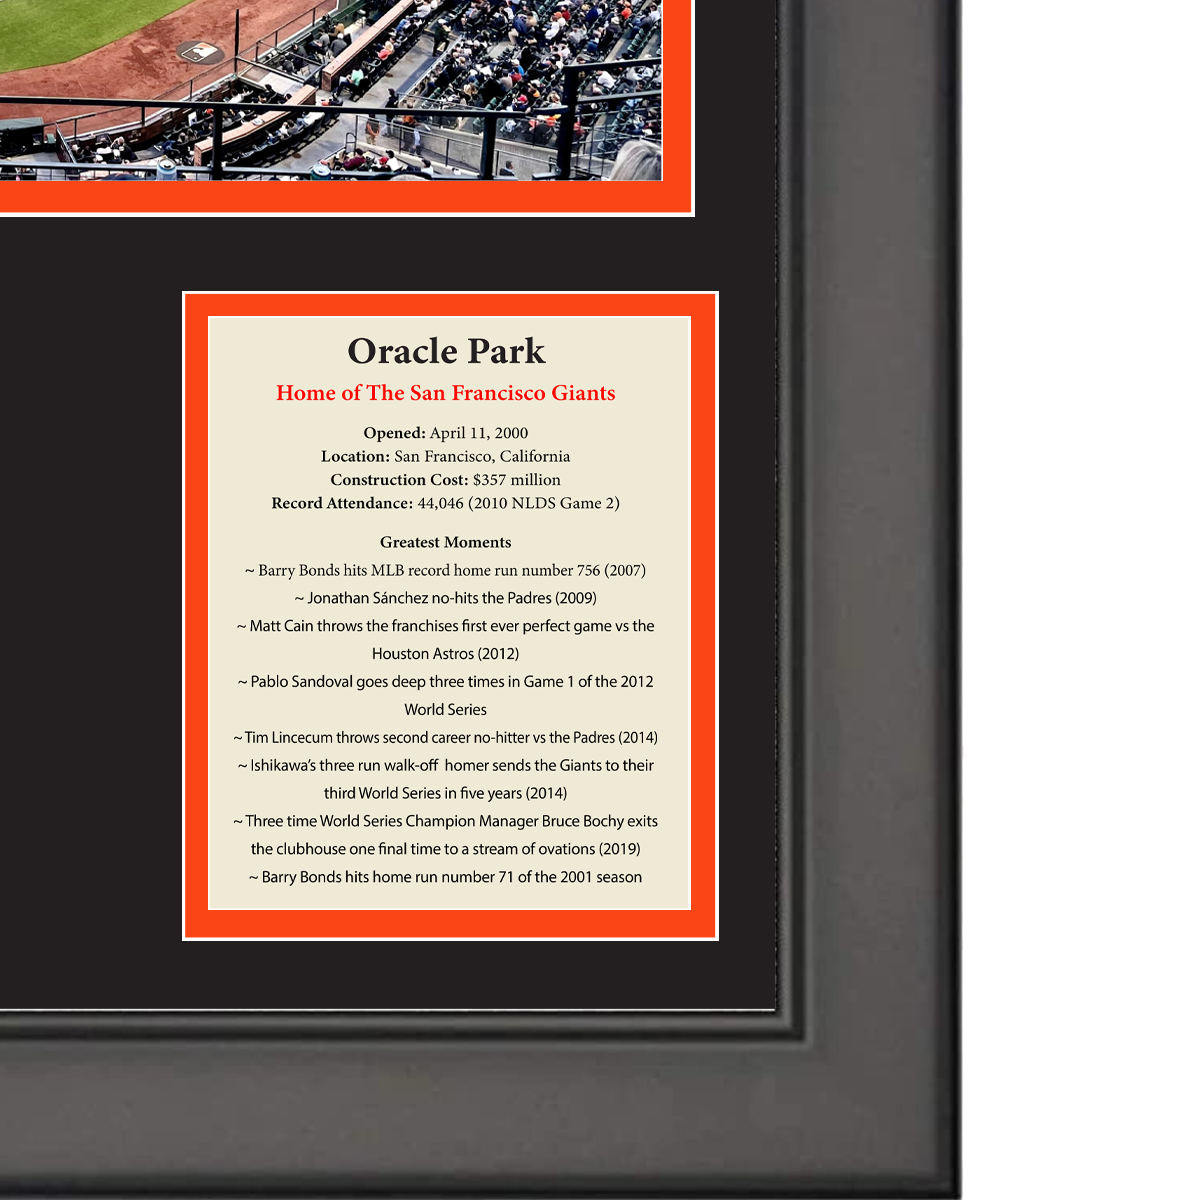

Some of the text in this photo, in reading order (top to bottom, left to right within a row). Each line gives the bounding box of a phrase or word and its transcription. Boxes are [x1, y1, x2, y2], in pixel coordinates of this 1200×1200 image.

[347, 336, 547, 365] Oracle Park
[276, 383, 616, 402] Home of The San Francisco Giants
[363, 425, 529, 443] Opened: April 11, 2000
[320, 448, 571, 464] Location: San Francisco, California
[330, 472, 561, 487] Construction Cost: $357 million
[271, 495, 620, 513] Record Attendance: 44,046 (2010 NLDS Game 2)
[379, 535, 512, 549] Greatest Moments
[307, 590, 597, 607] Jonathan Sánchez no-hits the Padres (2009)
[249, 618, 655, 636] Matt Cain throws the franchises first ever perfect game vs the
[372, 646, 520, 662] Houston Astros (2012)
[244, 730, 658, 746] Tim Lincecum throws second career no-hitter vs the Padres (2014)
